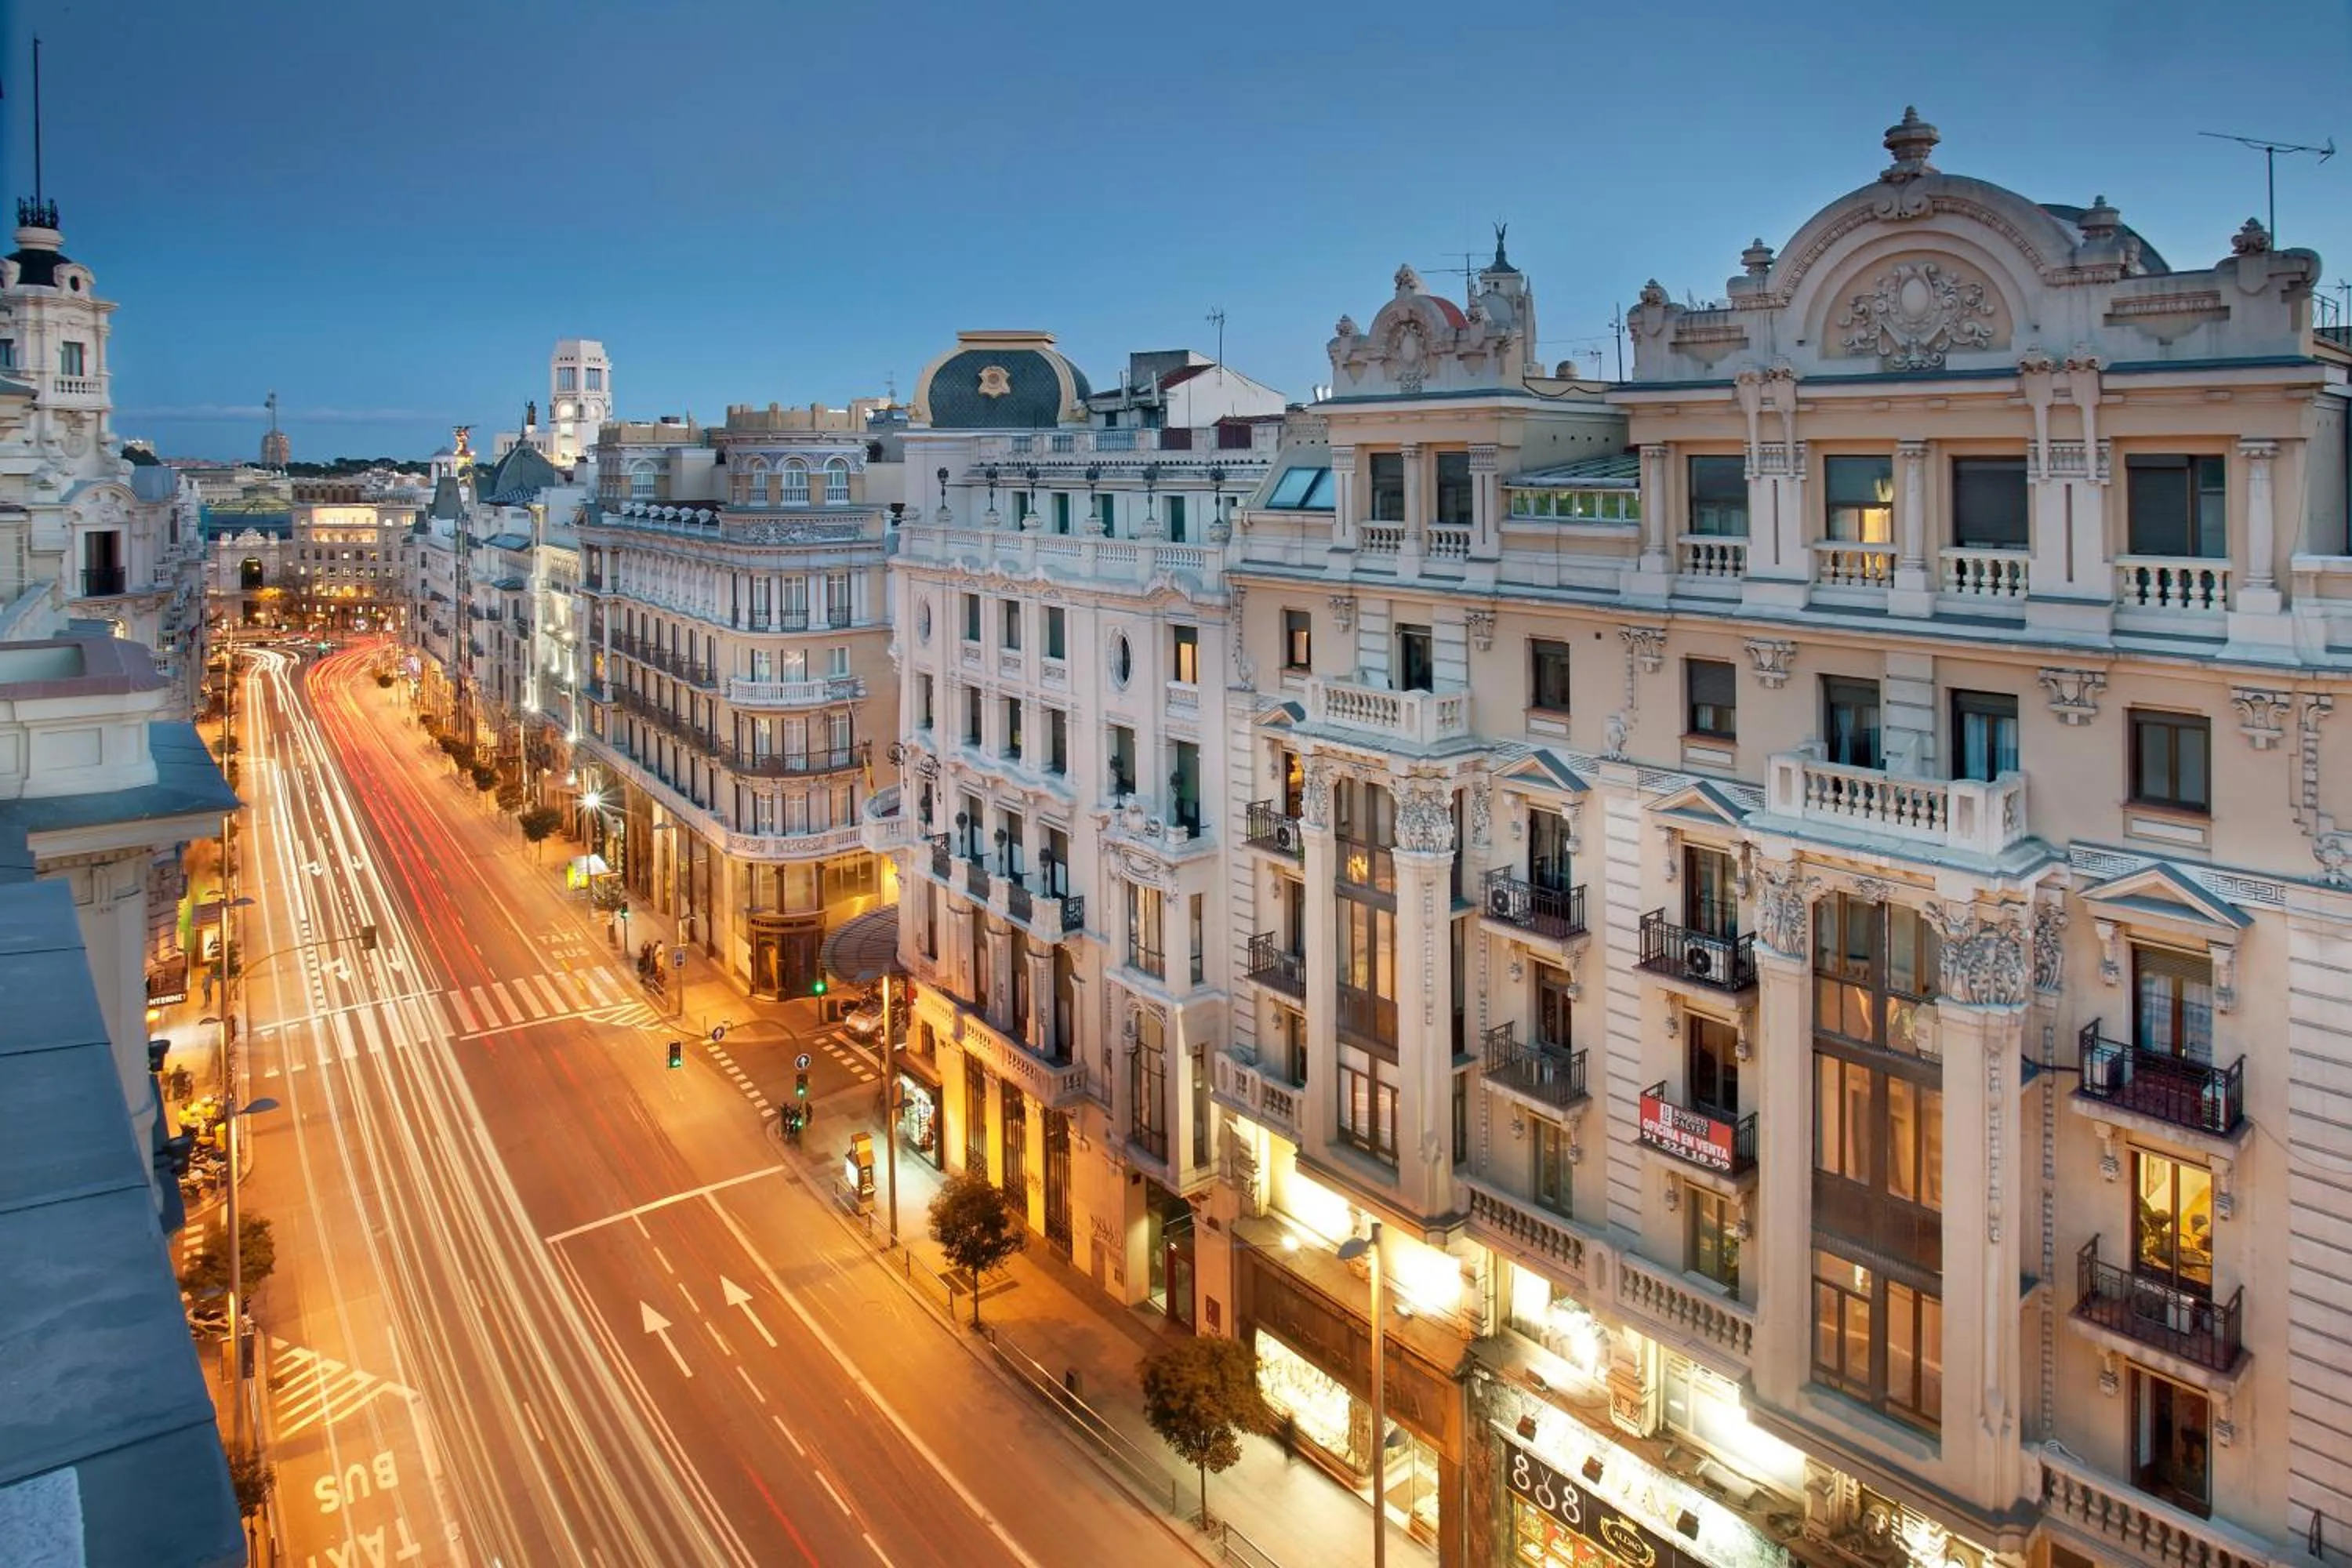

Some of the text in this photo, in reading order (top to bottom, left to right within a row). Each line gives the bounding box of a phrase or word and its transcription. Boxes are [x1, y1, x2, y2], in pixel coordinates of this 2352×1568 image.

[536, 931, 582, 945] TAXI
[551, 947, 590, 959] BUS
[1642, 1131, 1657, 1143] 91
[1642, 1117, 1679, 1142] OFICINA
[1680, 1132, 1694, 1149] EN
[1696, 1138, 1730, 1161] VENTA
[314, 1450, 399, 1514] BUS
